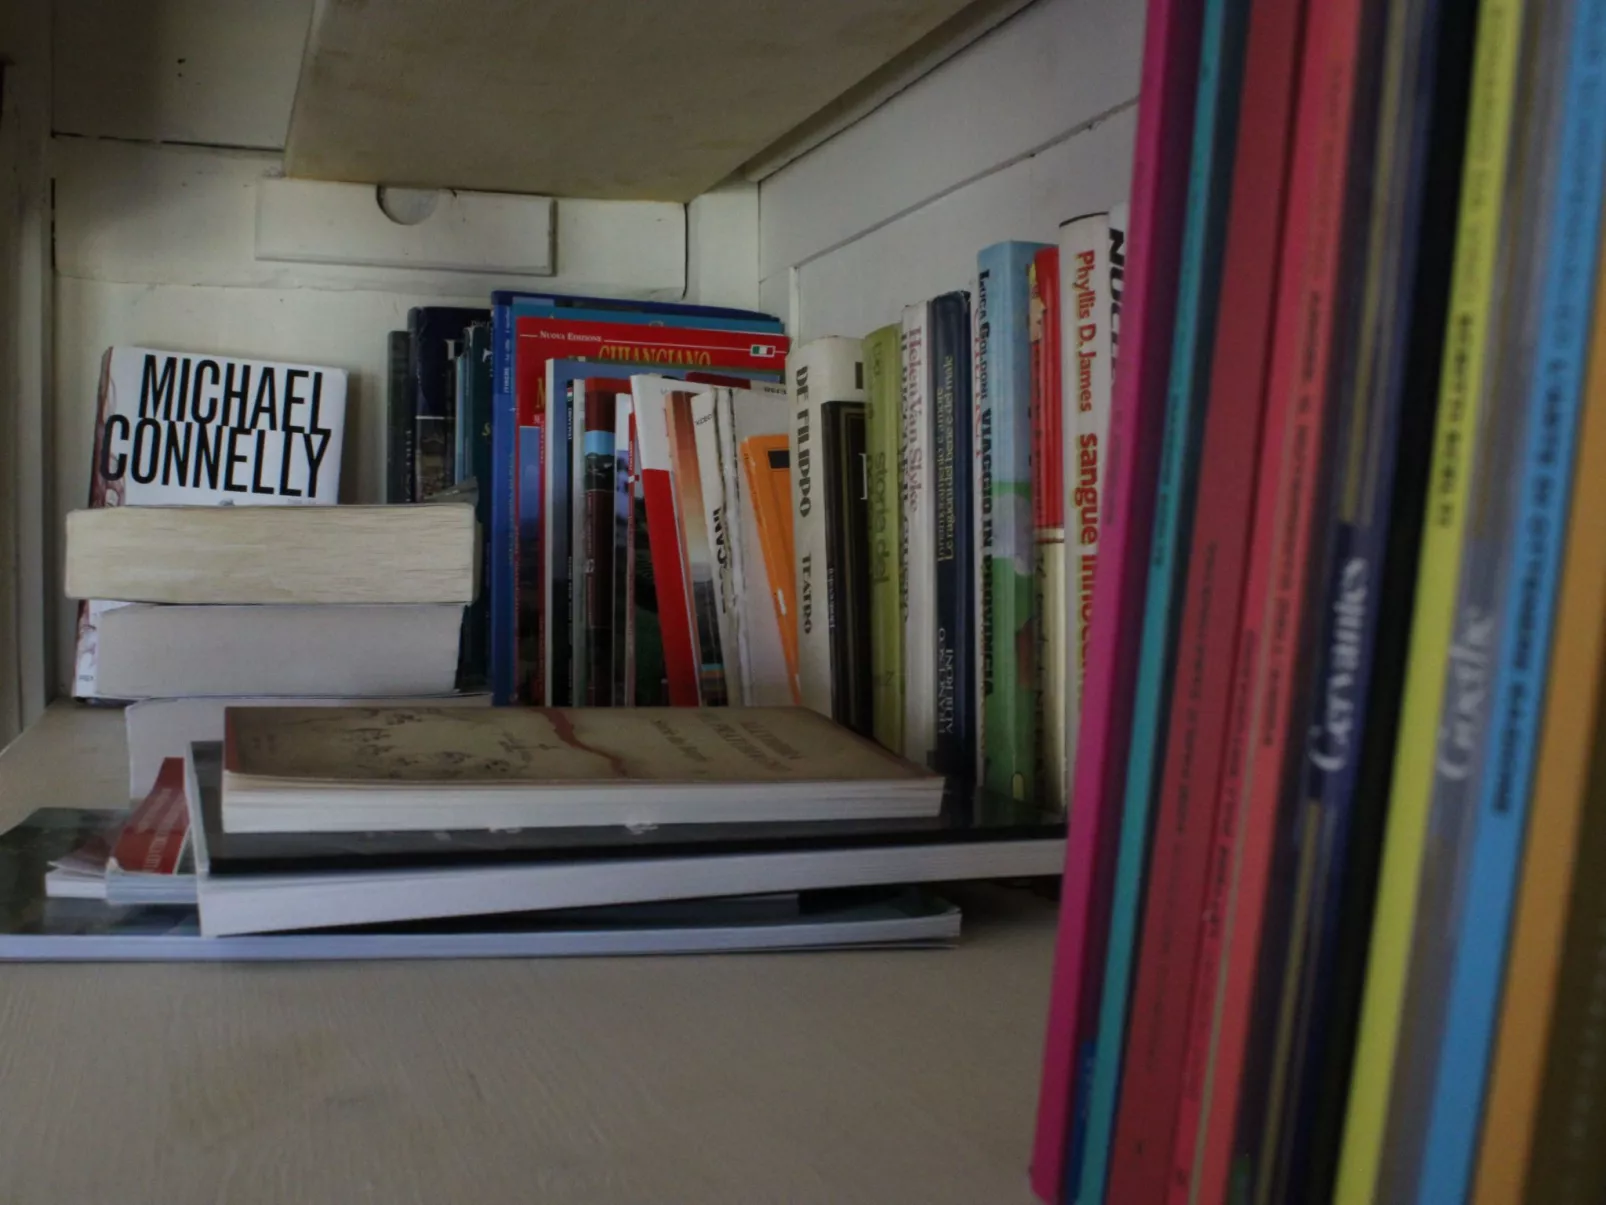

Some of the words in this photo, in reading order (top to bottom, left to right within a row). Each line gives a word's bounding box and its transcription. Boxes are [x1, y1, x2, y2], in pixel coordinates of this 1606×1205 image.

[1073, 249, 1095, 320] Phyllis
[908, 326, 922, 396] Helen
[1077, 325, 1097, 347] D.
[139, 353, 331, 435] MICHAEL
[796, 365, 809, 402] DE
[1077, 351, 1095, 413] James
[909, 396, 923, 444] Van
[100, 414, 332, 498] CONNELLY
[797, 409, 812, 518] FILIPPO
[908, 447, 924, 512] Slyke
[980, 407, 993, 511] VIAGGIO
[1074, 433, 1101, 545] sangue
[875, 451, 890, 533] storia
[982, 517, 994, 548] IN
